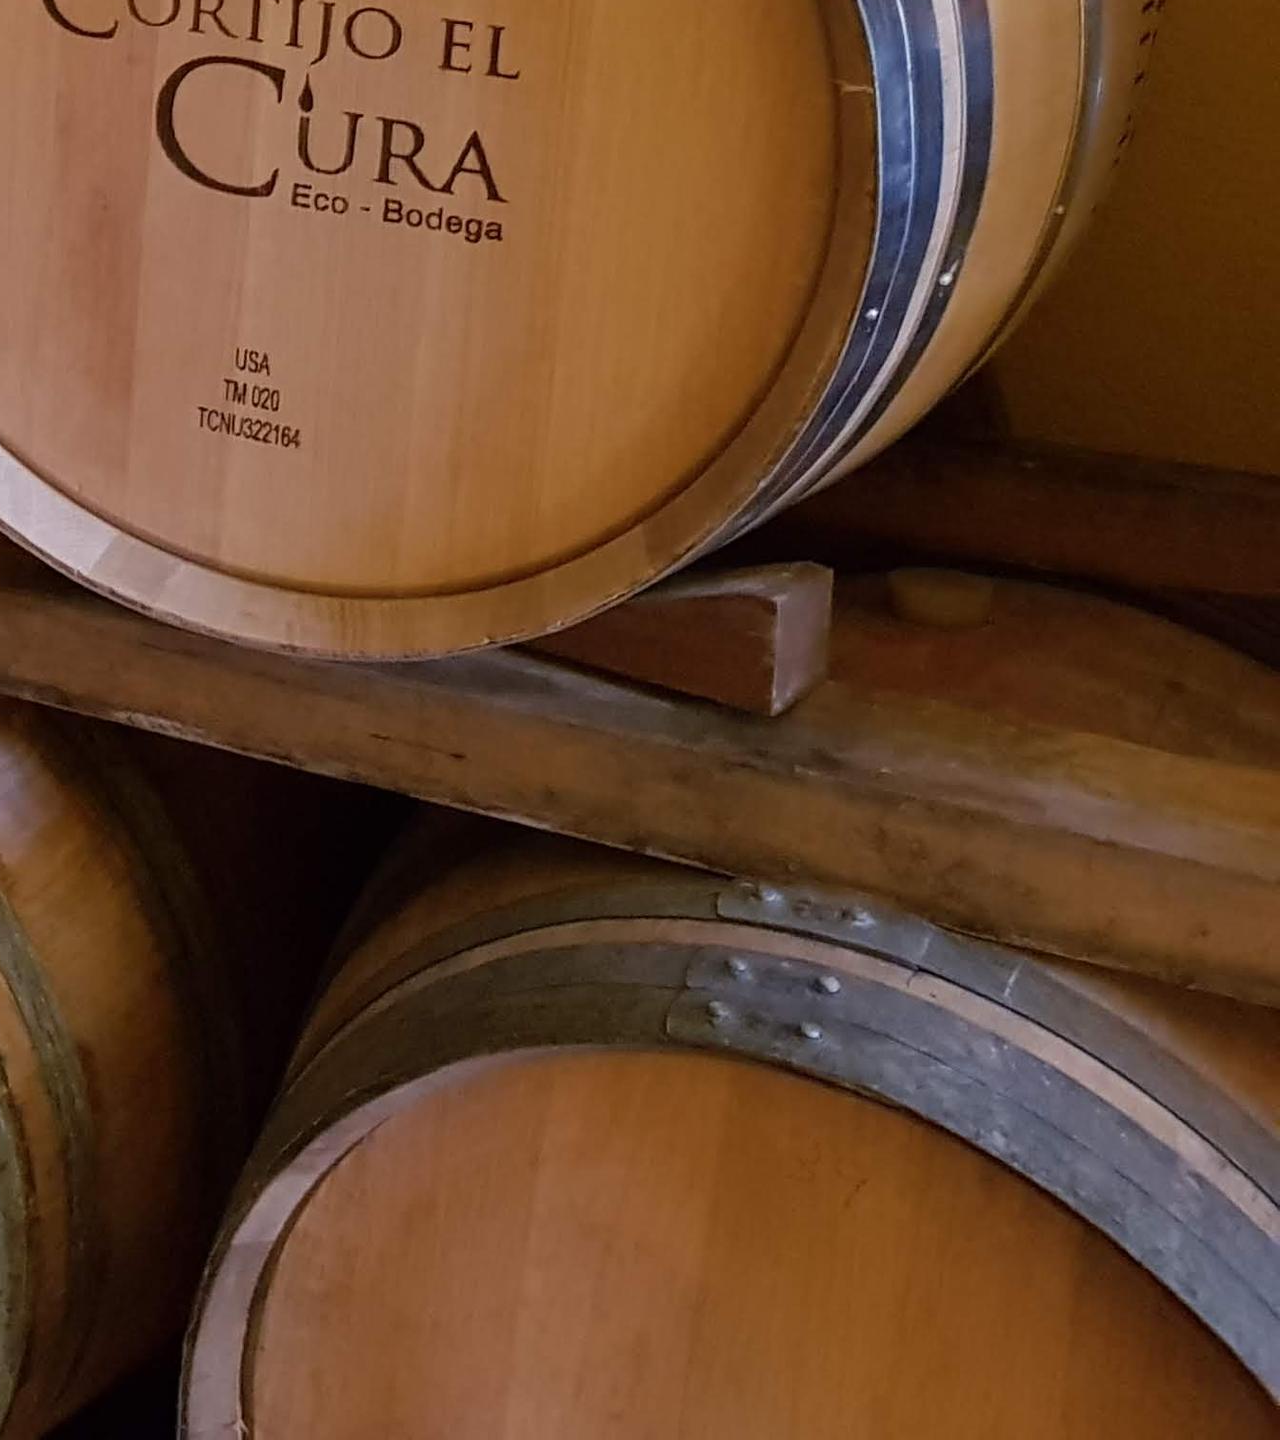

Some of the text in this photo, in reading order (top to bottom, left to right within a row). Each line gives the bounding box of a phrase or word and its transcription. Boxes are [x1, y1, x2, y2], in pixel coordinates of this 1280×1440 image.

[438, 17, 520, 80] EL
[155, 55, 509, 203] CURA
[290, 183, 349, 216] Eco
[382, 198, 504, 244] Bodega
[235, 347, 271, 377] USA
[224, 378, 281, 412] TM 020
[197, 406, 301, 449] TCNU322164
